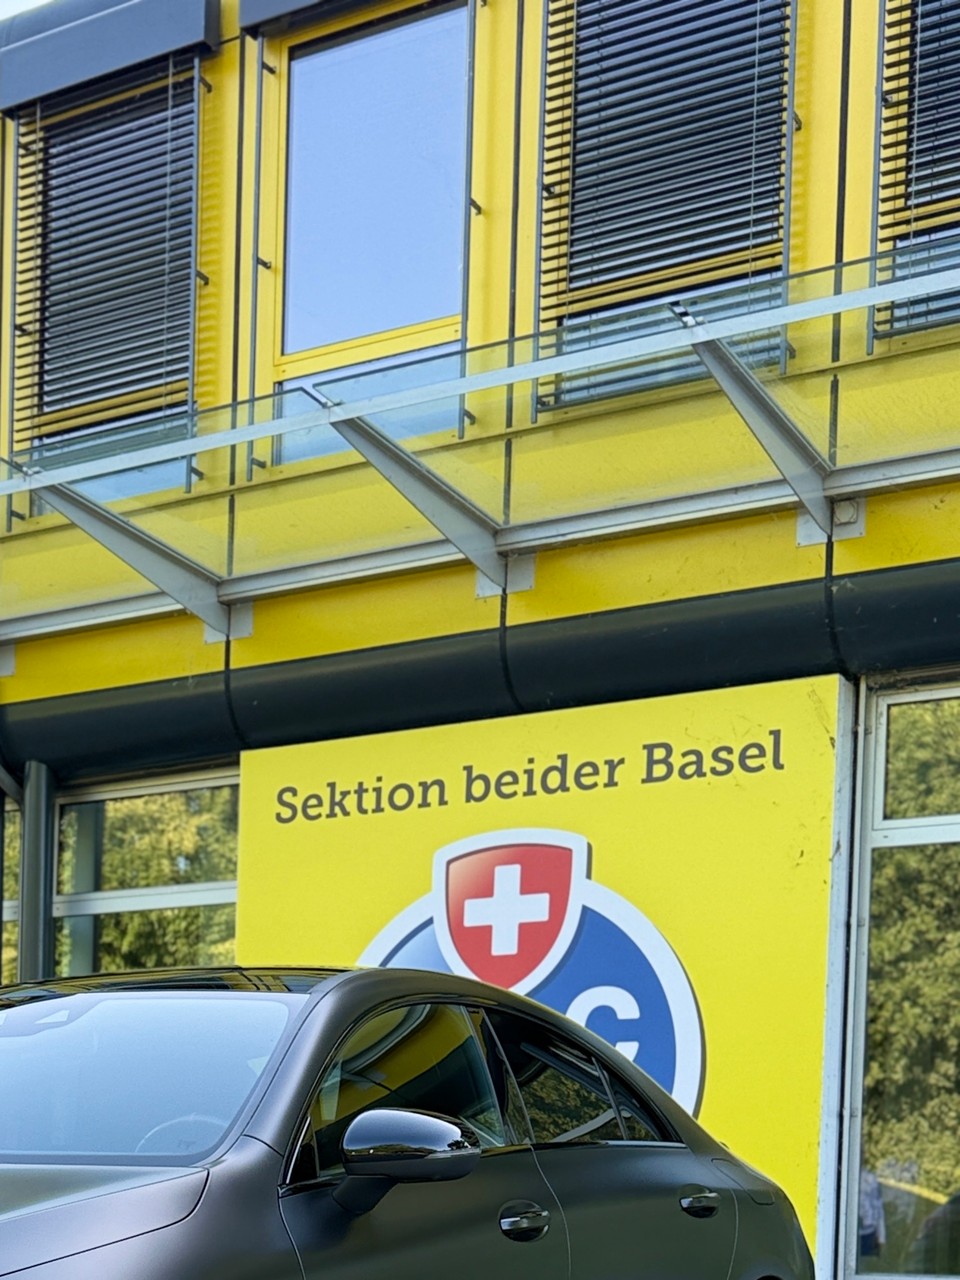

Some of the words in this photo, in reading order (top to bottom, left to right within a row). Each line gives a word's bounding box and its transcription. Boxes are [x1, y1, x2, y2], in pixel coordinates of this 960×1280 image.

[275, 774, 449, 824] Sektion
[462, 753, 626, 804] beider
[640, 729, 785, 785] Basel
